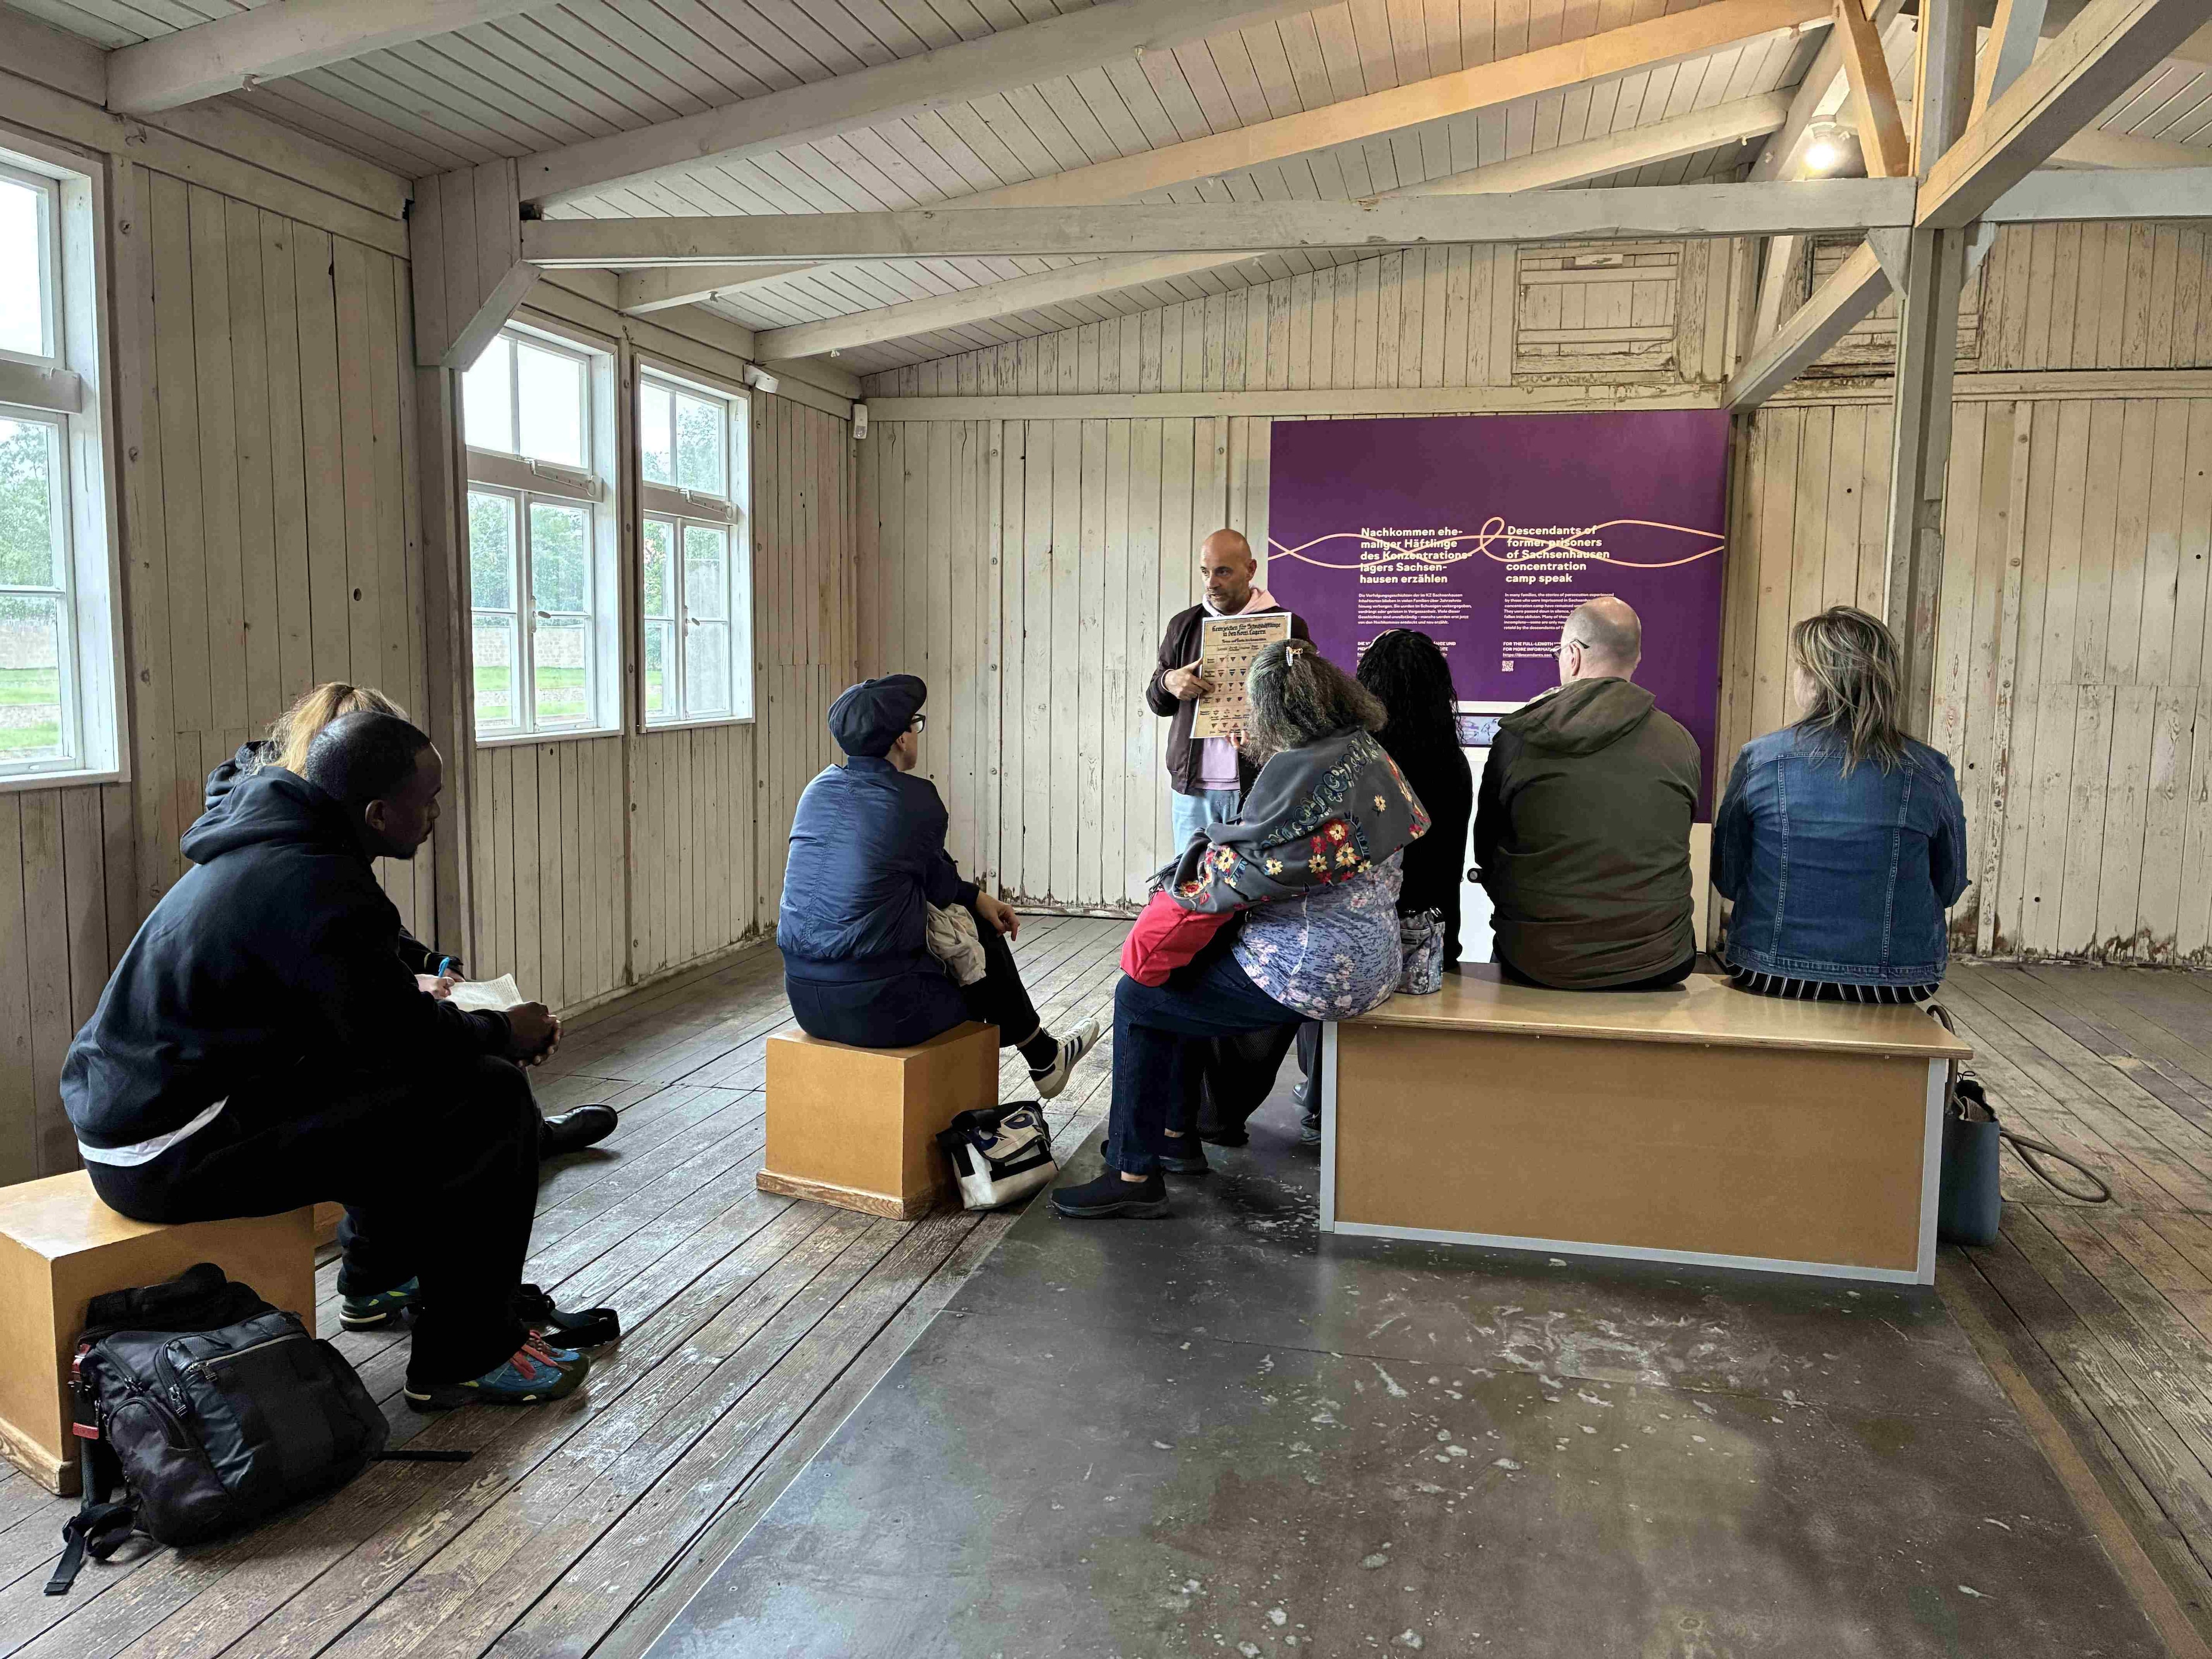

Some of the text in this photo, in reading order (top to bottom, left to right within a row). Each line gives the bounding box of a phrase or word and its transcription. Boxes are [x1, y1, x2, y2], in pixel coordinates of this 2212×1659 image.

[1361, 527, 1463, 536] Nachkommen ehe-
[1508, 525, 1597, 535] Descendants of
[1361, 539, 1457, 550] maliger Häftlinge
[1507, 537, 1602, 548] former prisoners
[1360, 551, 1472, 560] des Konzentrations-
[1506, 550, 1610, 559] of Sachsenhausen
[1360, 562, 1447, 574] lagers Sachsen-
[1506, 561, 1586, 571] concentration
[1360, 574, 1448, 584] hausen erzählen
[1506, 573, 1573, 585] camp speak
